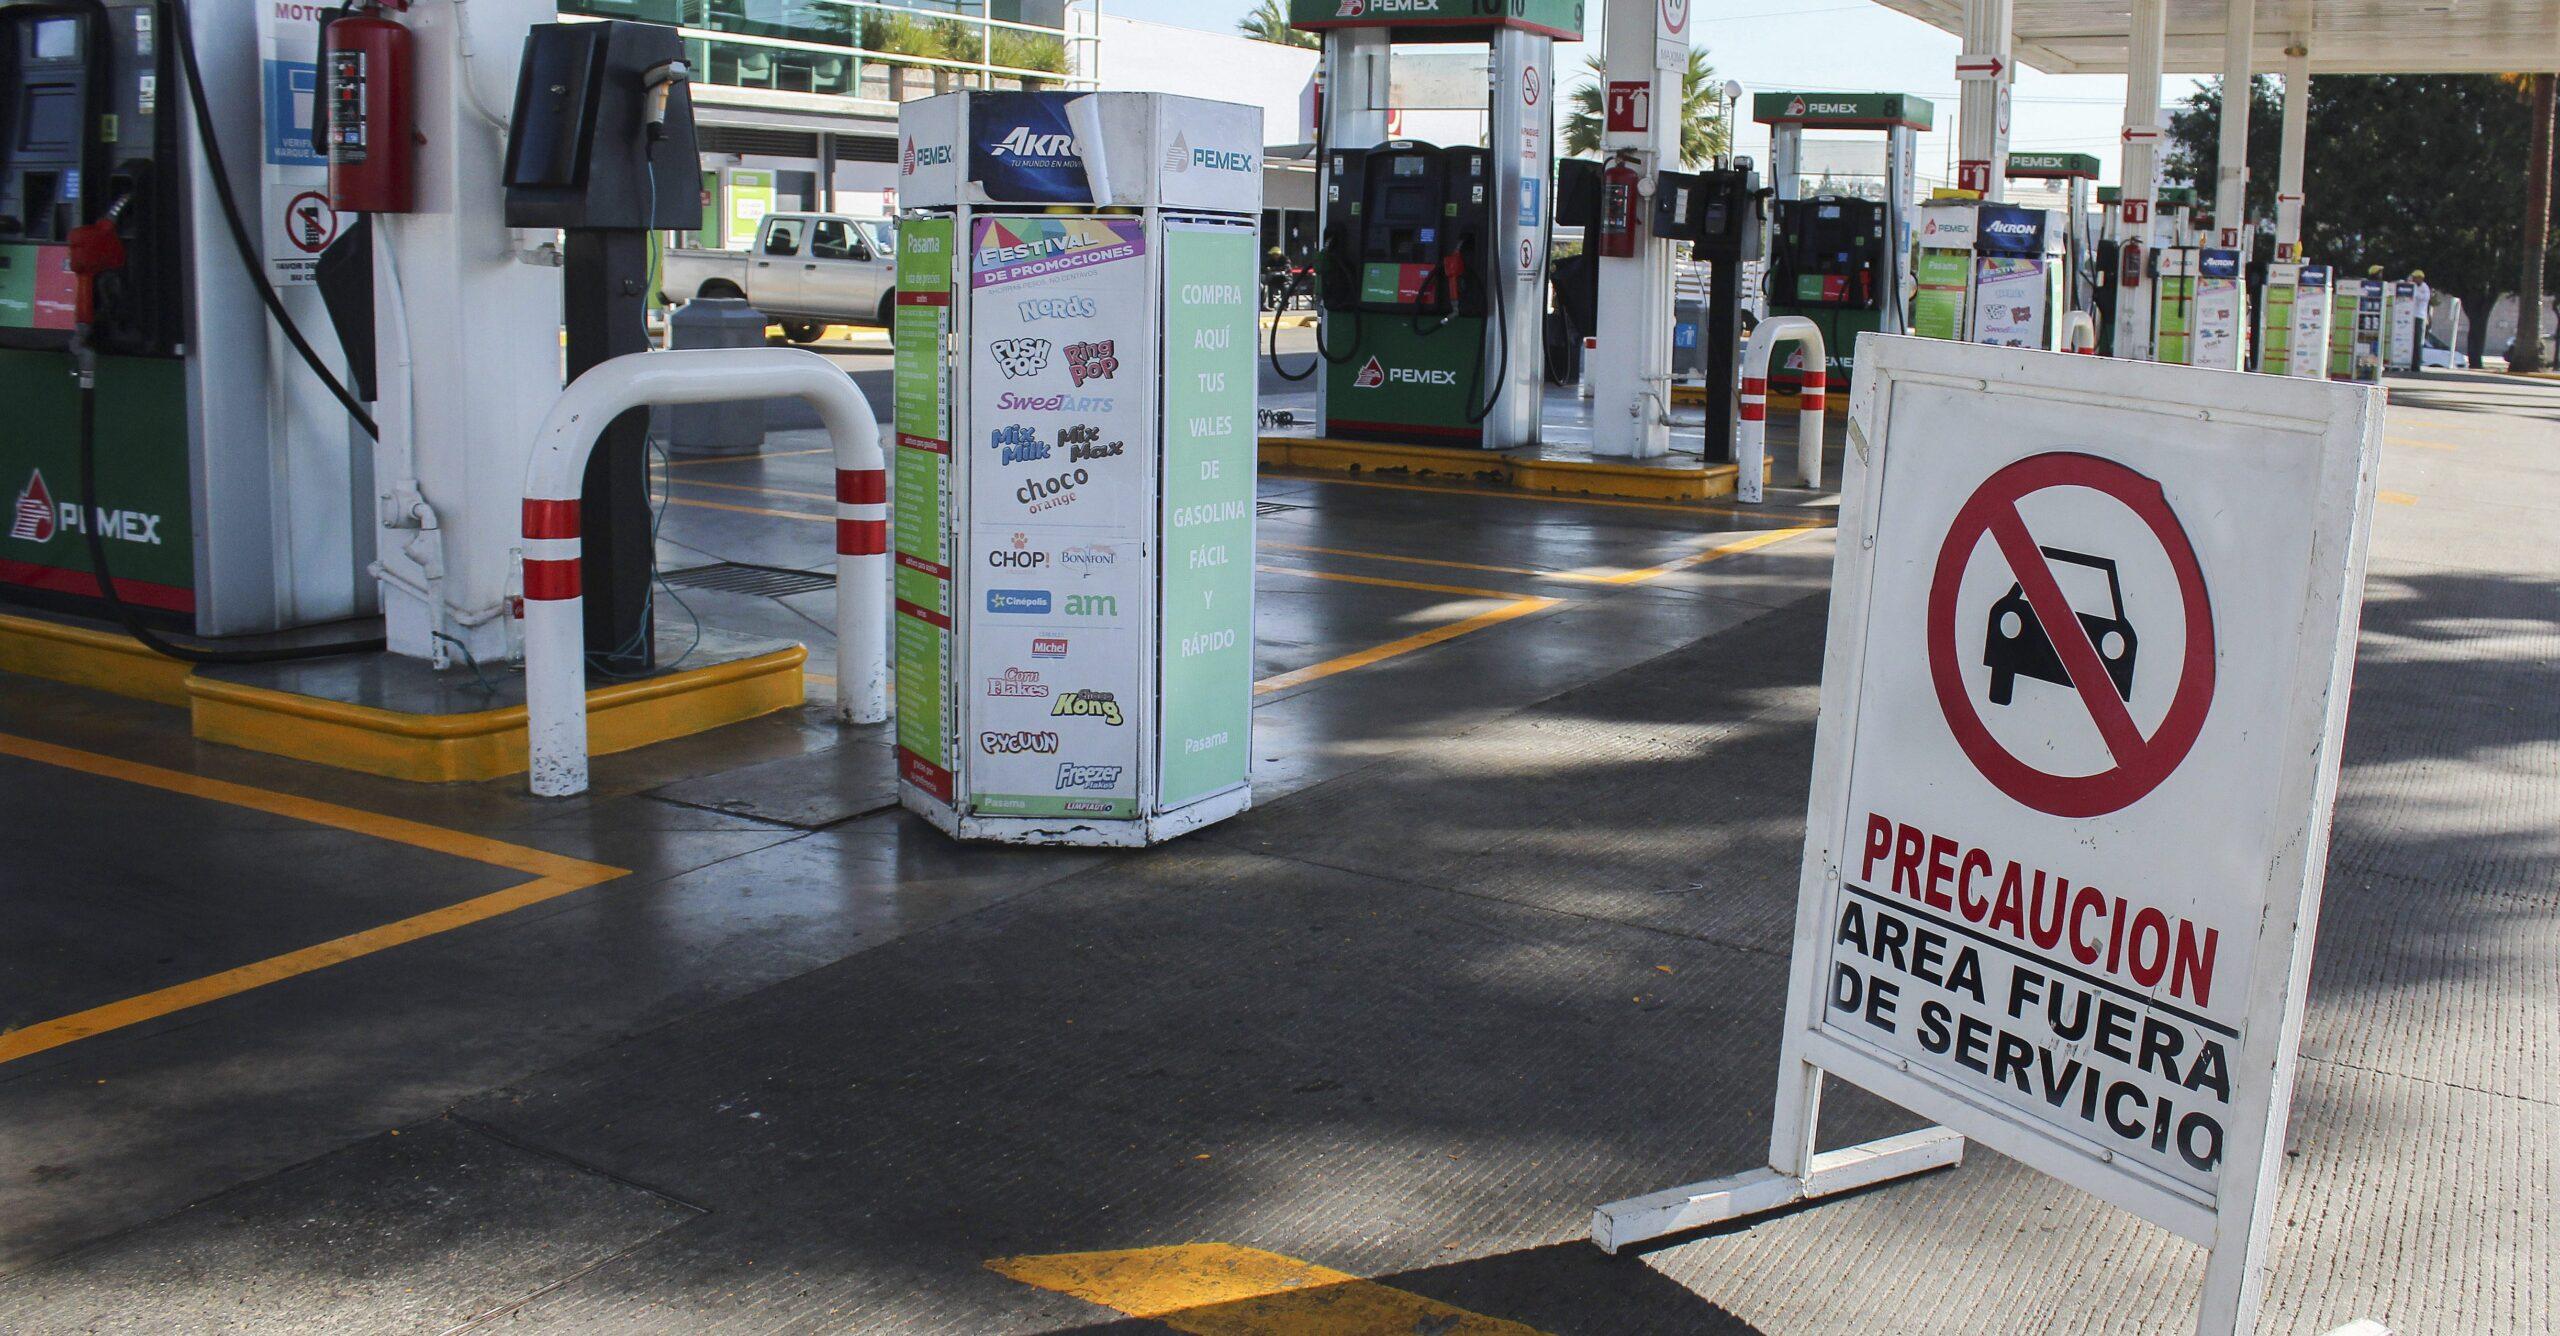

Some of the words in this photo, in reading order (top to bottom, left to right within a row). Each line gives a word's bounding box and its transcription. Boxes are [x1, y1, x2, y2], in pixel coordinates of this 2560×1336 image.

[1370, 0, 1439, 11] PEMEX
[1809, 103, 1857, 113] PEMEX
[1884, 99, 1898, 117] 8
[917, 145, 952, 166] PEMEX
[1022, 160, 1050, 168] MUNDO
[1051, 160, 1062, 168] EN
[1194, 148, 1252, 172] PEMEX
[2011, 157, 2062, 167] PEMEX
[1938, 224, 1969, 233] PEMEX
[1986, 220, 2036, 234] AKRON
[908, 233, 940, 254] Pasama
[979, 232, 1099, 267] FESTIVAL
[984, 270, 1008, 284] DE
[1011, 245, 1134, 278] PROMOCIONES
[2204, 257, 2235, 267] AKRON
[1181, 284, 1241, 304] COMPRA
[1194, 325, 1231, 351] AQUÍ
[990, 338, 1051, 363] PUSH
[1063, 339, 1115, 366] Ring
[1001, 357, 1047, 379] POP
[1389, 367, 1456, 385] PEMEX
[1198, 373, 1225, 392] TUS
[992, 423, 1036, 449] Mix
[1057, 423, 1100, 447] Mix
[1189, 416, 1232, 437] VALES
[1002, 441, 1051, 466] Milk
[1070, 440, 1124, 463] Max
[1200, 460, 1220, 480] DE
[1016, 468, 1089, 504] choco
[1029, 491, 1077, 514] orange
[1173, 500, 1246, 528] GASOLINA
[989, 550, 1050, 568] CHOP!
[1189, 544, 1229, 569] FÁCIL
[1064, 594, 1118, 617] am
[1203, 590, 1213, 610] Y
[1034, 642, 1066, 653] Michel
[1181, 628, 1236, 657] RÁPIDO
[1005, 667, 1040, 682] Corn
[988, 677, 1049, 697] Flakes
[1051, 693, 1124, 726] Kong
[1185, 730, 1228, 754] Pasama
[1056, 762, 1122, 790] Freezer
[984, 798, 1025, 808] Pasama
[1861, 812, 2219, 1009] PRECAUCION
[1837, 900, 1986, 1006] AREA
[2008, 964, 2230, 1104] FUERA
[1829, 960, 1900, 1035] DE
[1916, 1000, 2224, 1173] SERVICIO
